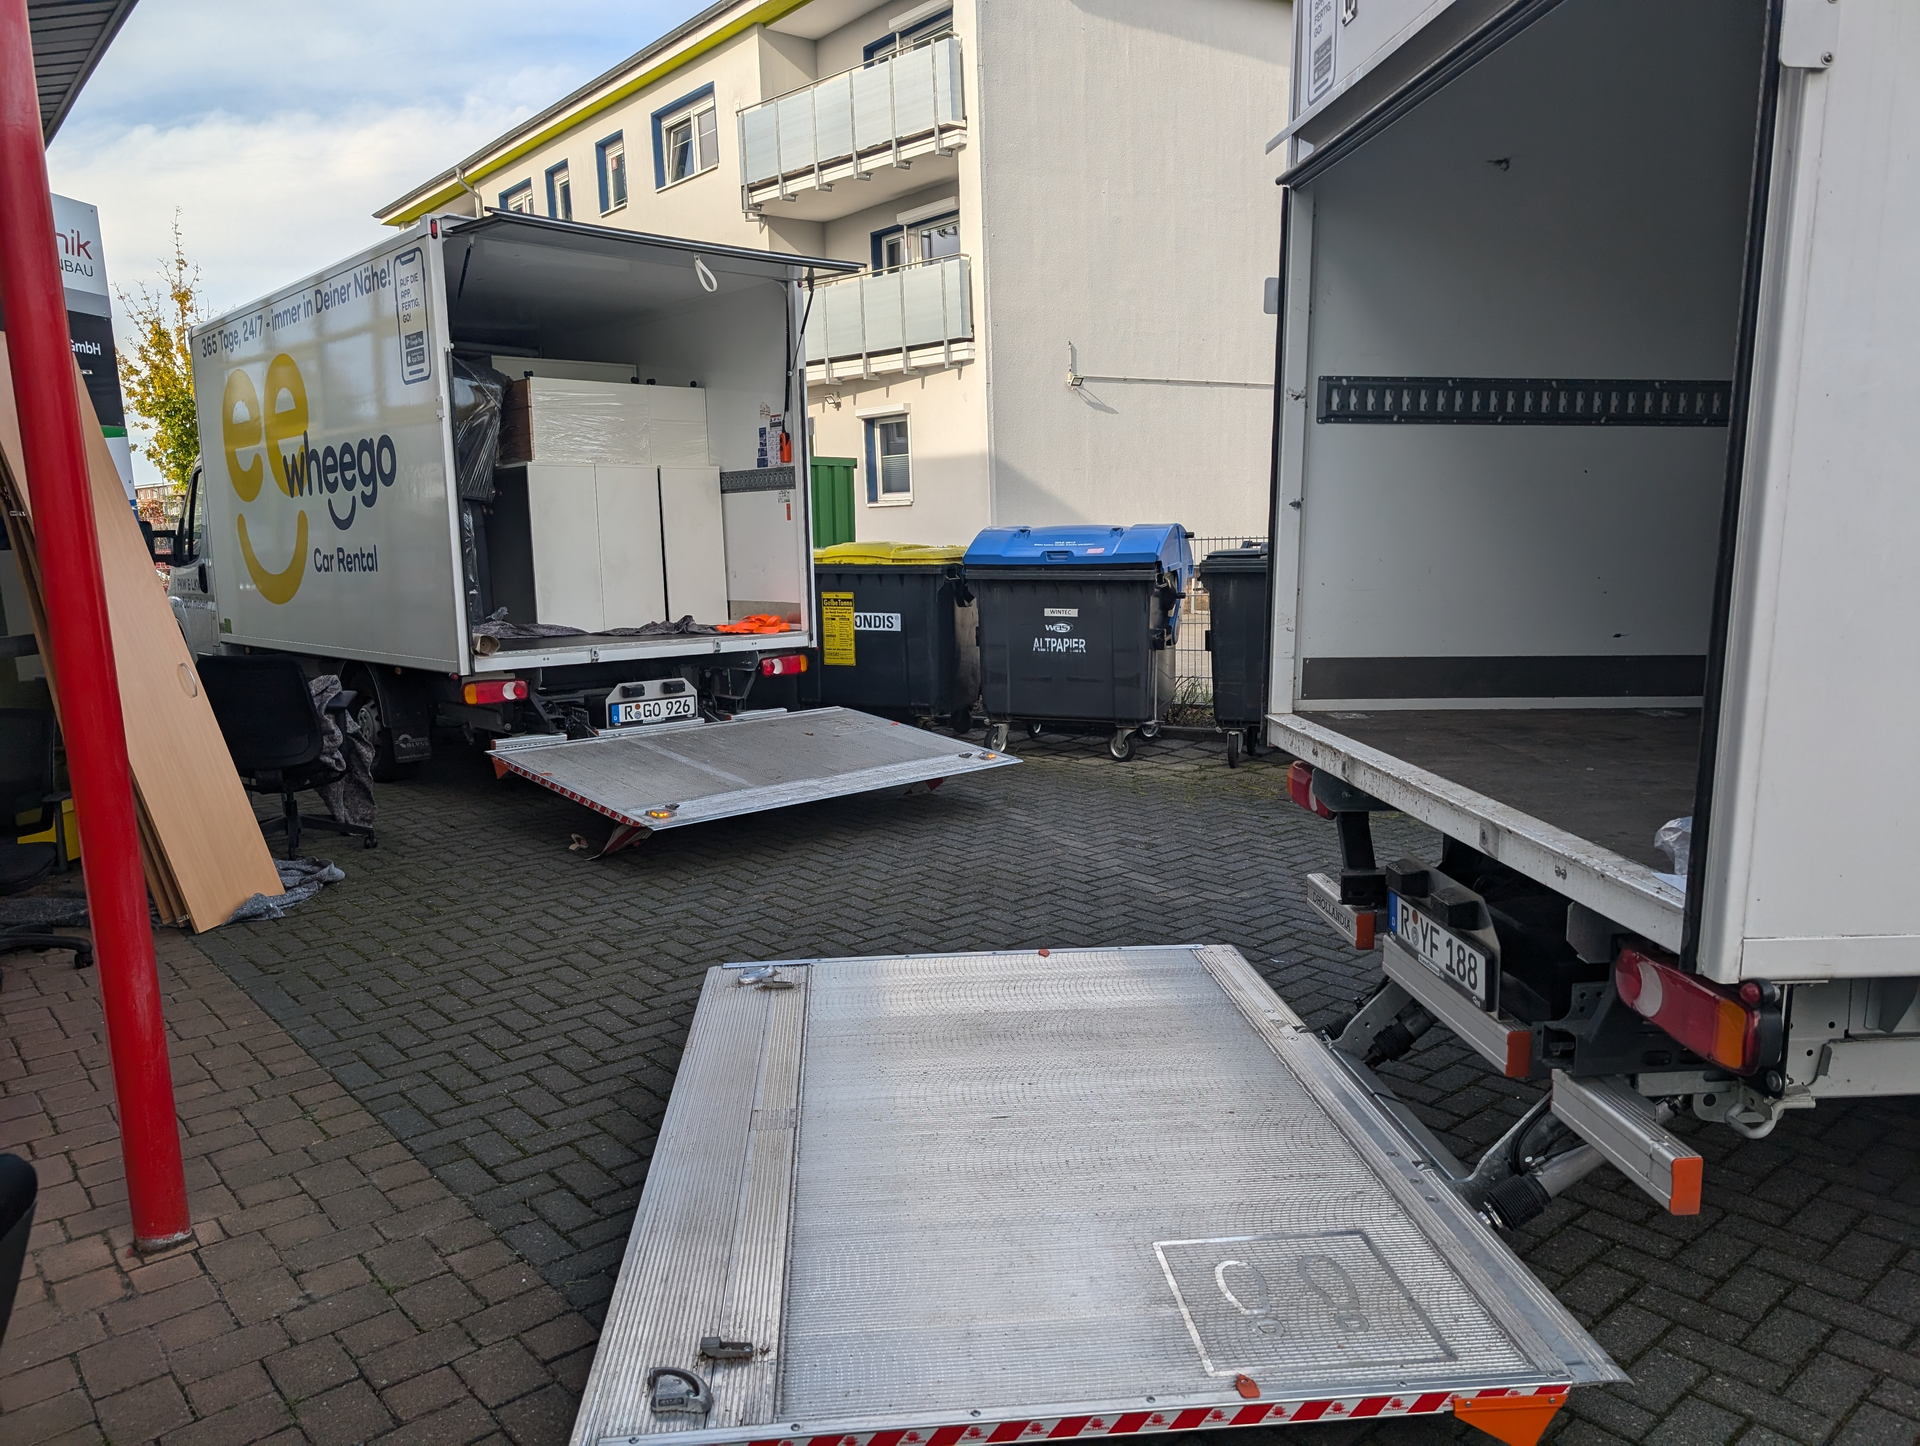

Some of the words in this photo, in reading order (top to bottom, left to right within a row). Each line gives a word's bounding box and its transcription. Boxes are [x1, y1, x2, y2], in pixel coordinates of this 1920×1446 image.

[400, 276, 409, 288] AUF
[410, 272, 419, 283] DIE
[400, 288, 411, 300] APP,
[201, 333, 217, 358] 365
[218, 329, 241, 353] Tage,
[243, 314, 263, 342] 24/7
[271, 302, 302, 332] immer
[303, 293, 313, 319] in
[315, 282, 352, 314] Deiner
[354, 259, 391, 298] Nähe!
[402, 298, 420, 312] FERTIG,
[402, 312, 411, 324] GO!
[282, 430, 397, 508] wheego
[313, 547, 334, 573] Car
[337, 544, 378, 573] Rental
[1033, 637, 1086, 653] ALTPAPIER
[624, 705, 633, 720] R
[643, 702, 661, 718] GO
[666, 699, 690, 716] 926
[1312, 891, 1352, 930] DHOLLANDIA
[1391, 917, 1395, 926] D
[1401, 904, 1410, 940] R
[1420, 917, 1440, 959] YF
[1445, 937, 1478, 991] 188
